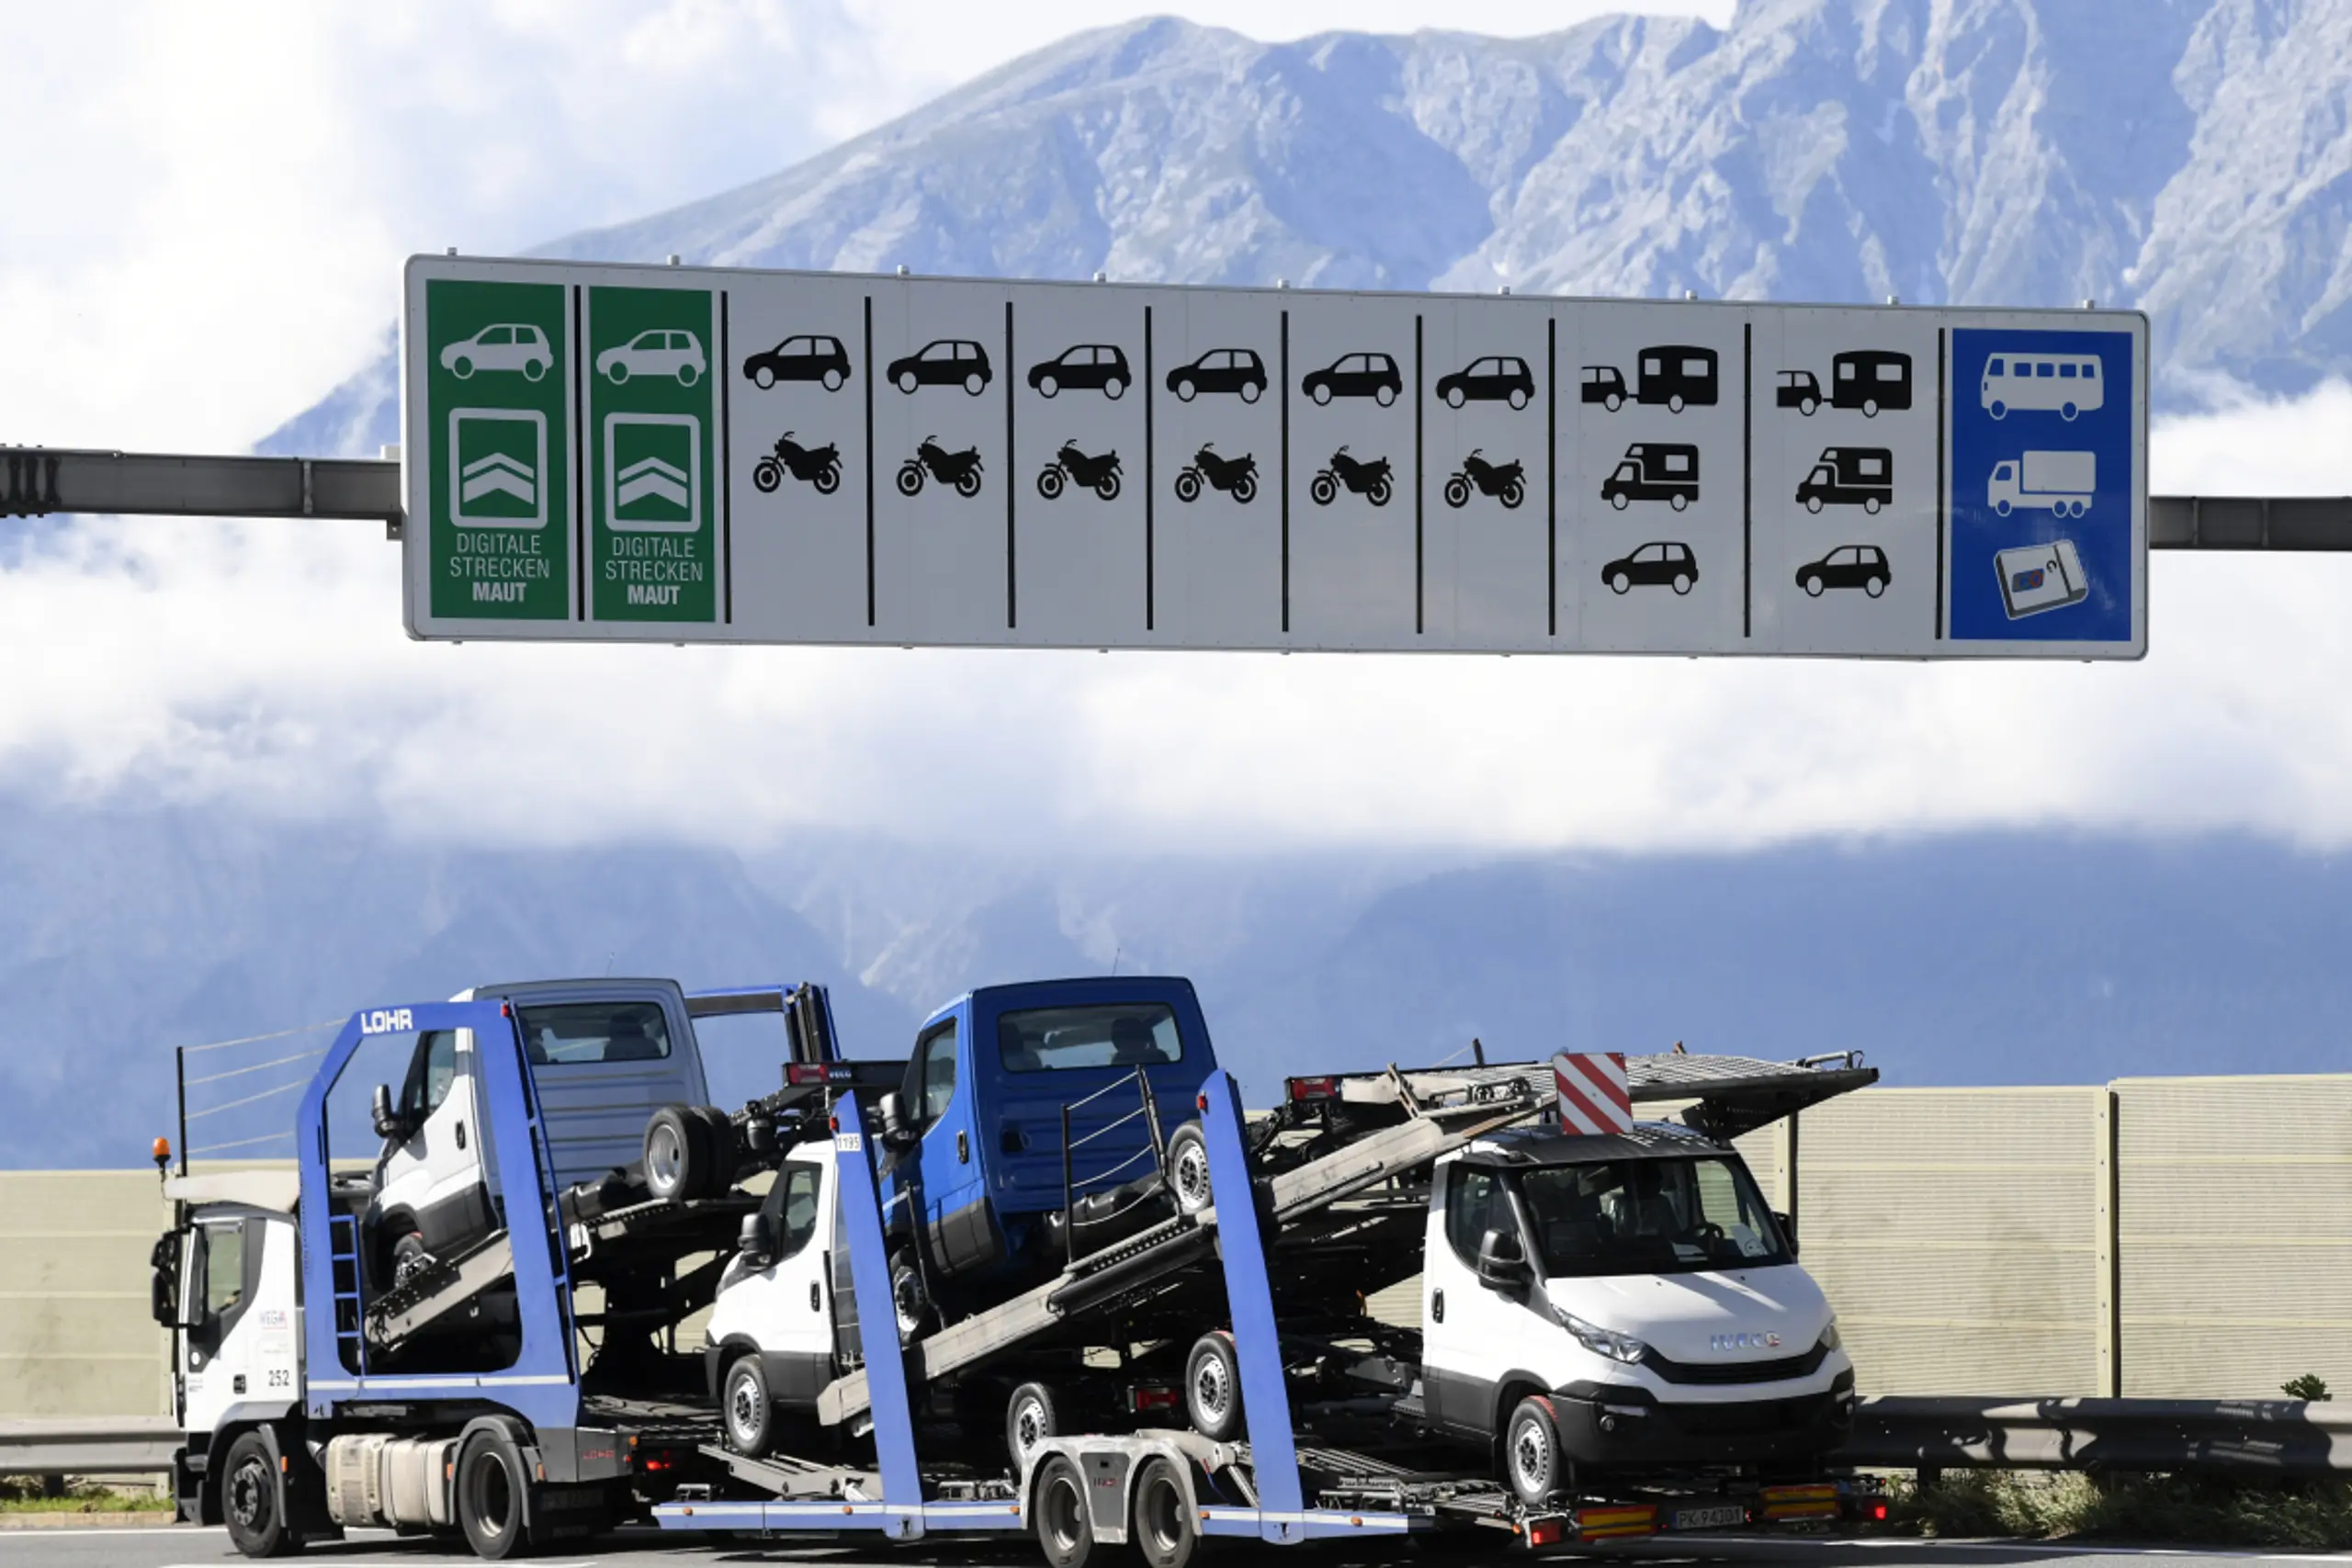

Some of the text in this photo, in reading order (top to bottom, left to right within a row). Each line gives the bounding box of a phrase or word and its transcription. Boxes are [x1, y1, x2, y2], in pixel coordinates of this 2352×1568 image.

[457, 533, 542, 555] DIGITALE
[613, 536, 695, 558] DIGITALE
[450, 557, 550, 579] STRECKEN
[605, 560, 704, 582] STRECKEN
[472, 581, 527, 604] MAUT
[628, 585, 681, 606] MAUT
[361, 1009, 413, 1033] LOHR
[837, 1135, 861, 1150] 1195
[268, 1370, 290, 1387] 252
